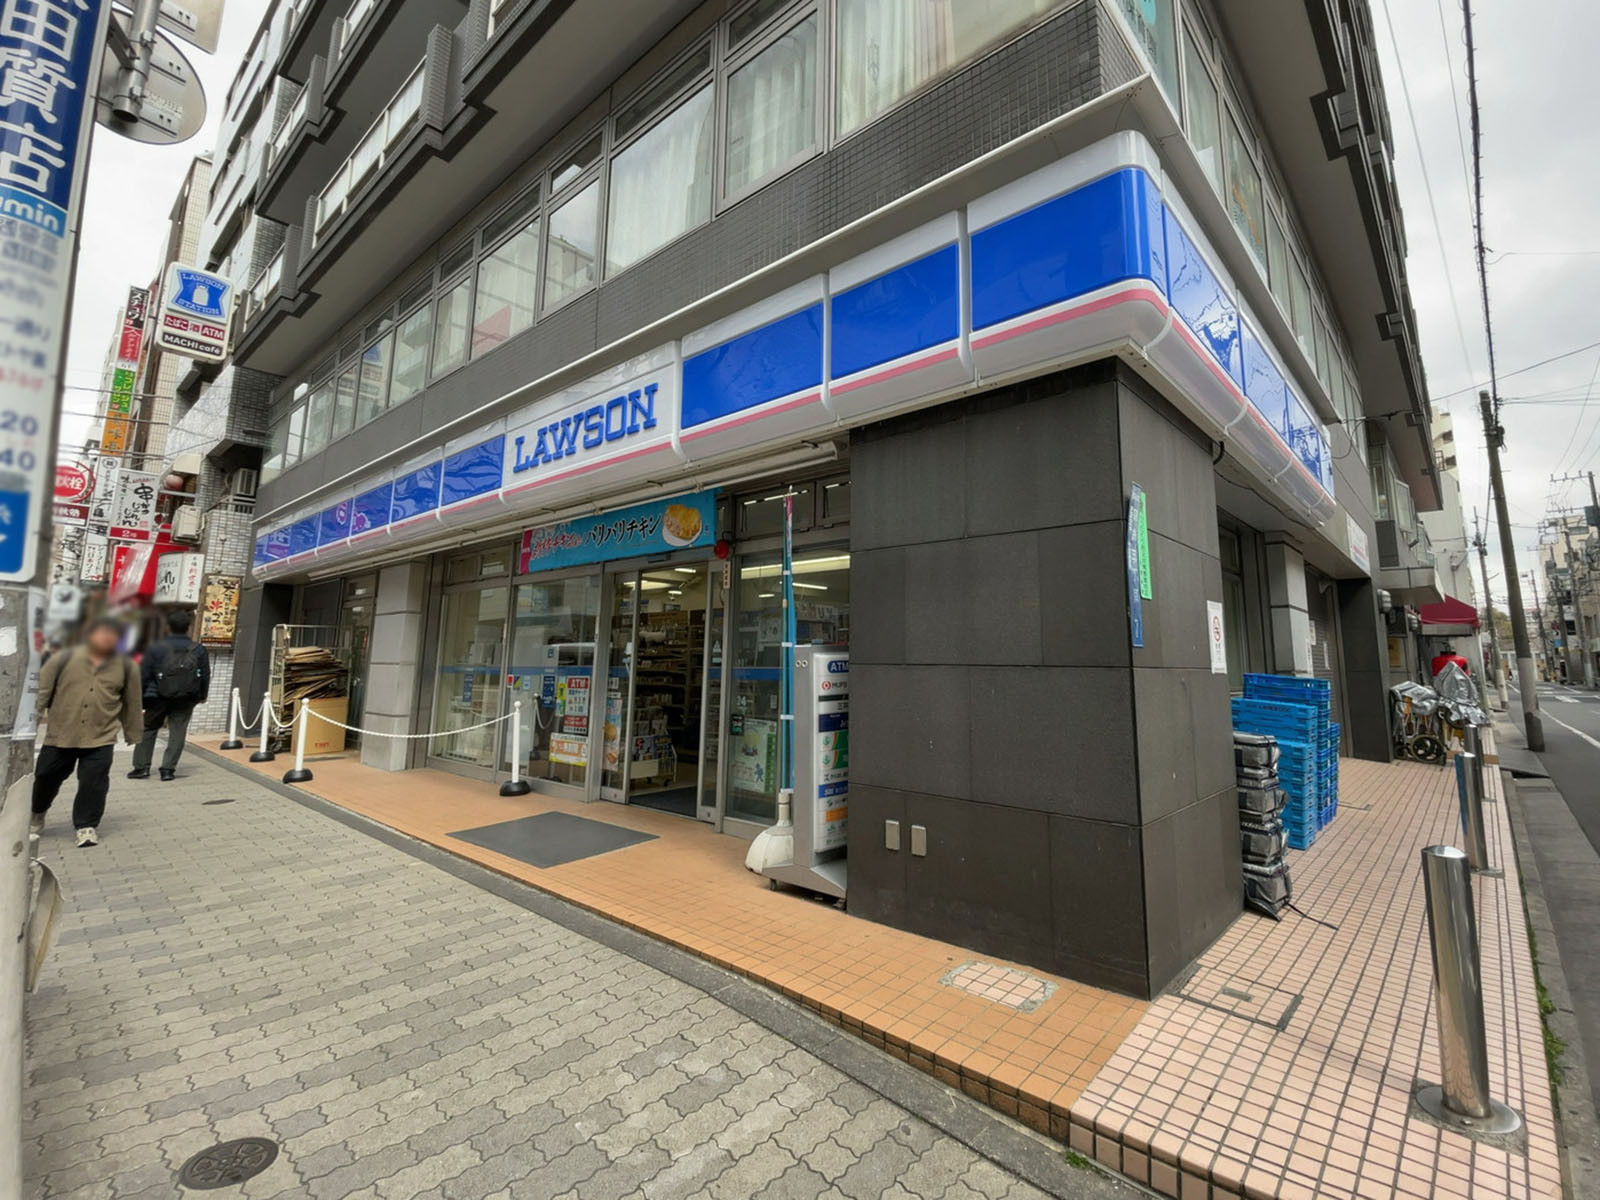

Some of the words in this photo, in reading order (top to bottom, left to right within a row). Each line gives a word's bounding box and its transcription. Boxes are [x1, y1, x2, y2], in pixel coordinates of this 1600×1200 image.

[0, 0, 89, 193] 田質店
[182, 273, 226, 291] LAWSON
[177, 299, 220, 316] STATION
[165, 316, 188, 330] たばこ
[201, 326, 224, 339] ATM
[164, 334, 198, 349] MACHI
[513, 383, 659, 473] LAWSON
